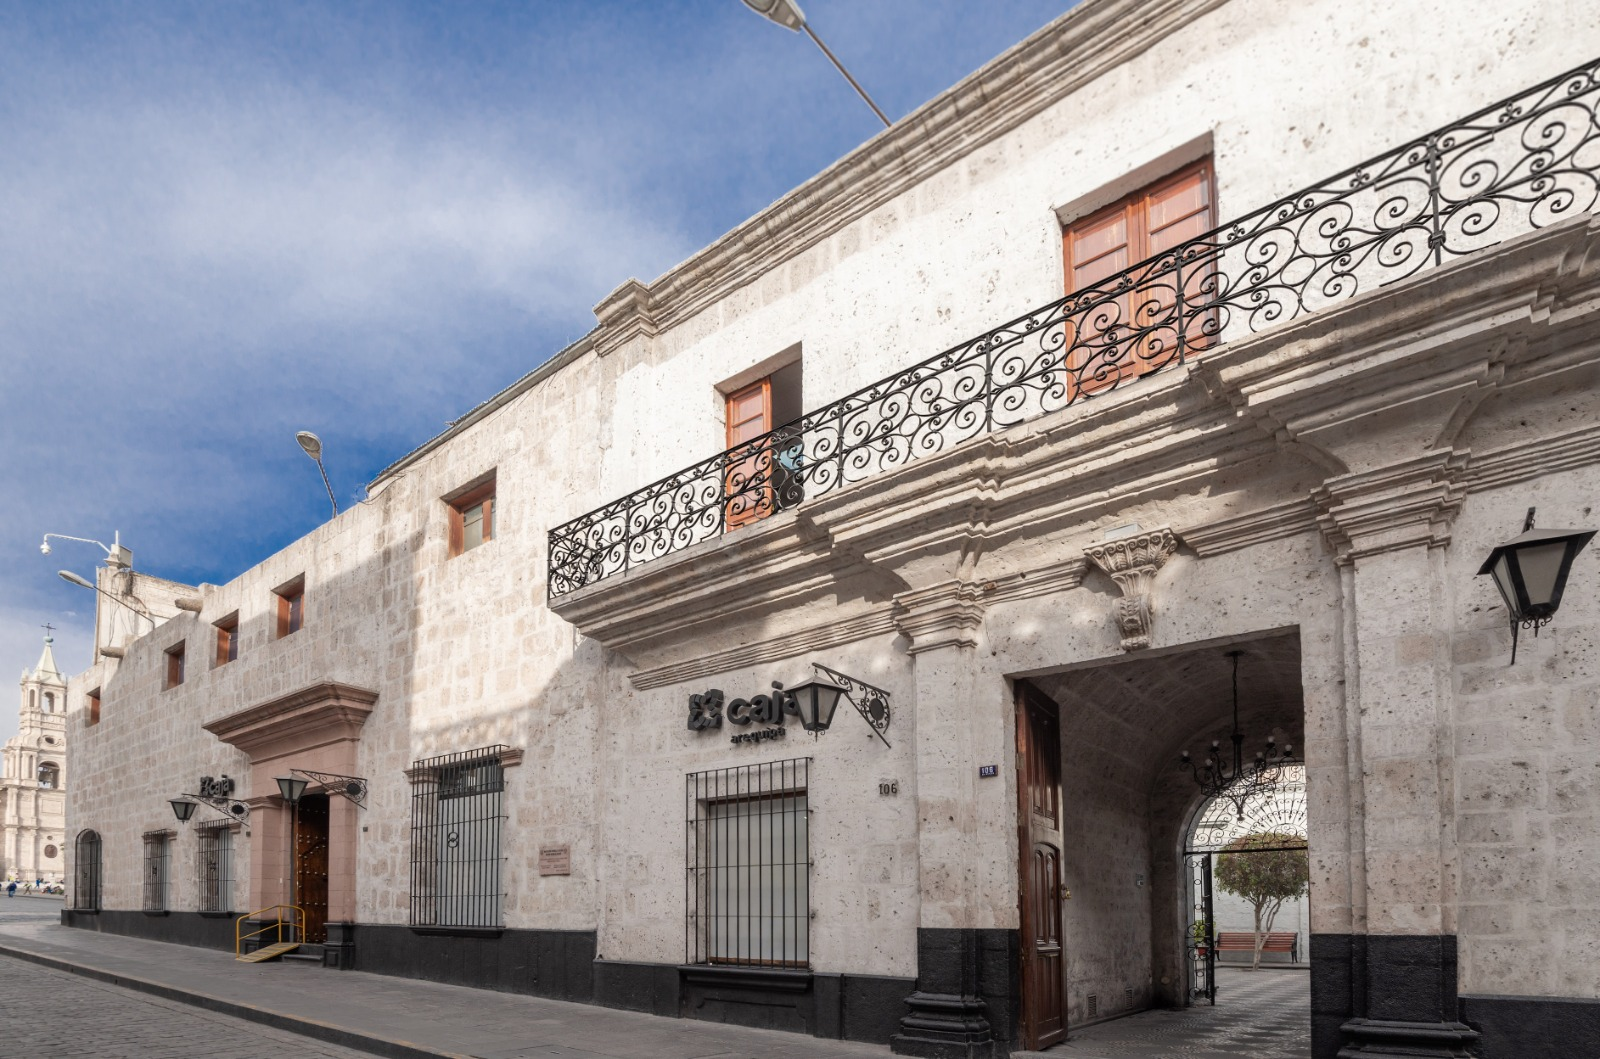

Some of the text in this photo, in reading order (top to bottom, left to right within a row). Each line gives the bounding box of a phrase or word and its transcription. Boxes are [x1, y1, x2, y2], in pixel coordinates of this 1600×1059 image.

[730, 727, 786, 744] arequipa
[208, 774, 231, 797] caja
[879, 783, 897, 795] 106
